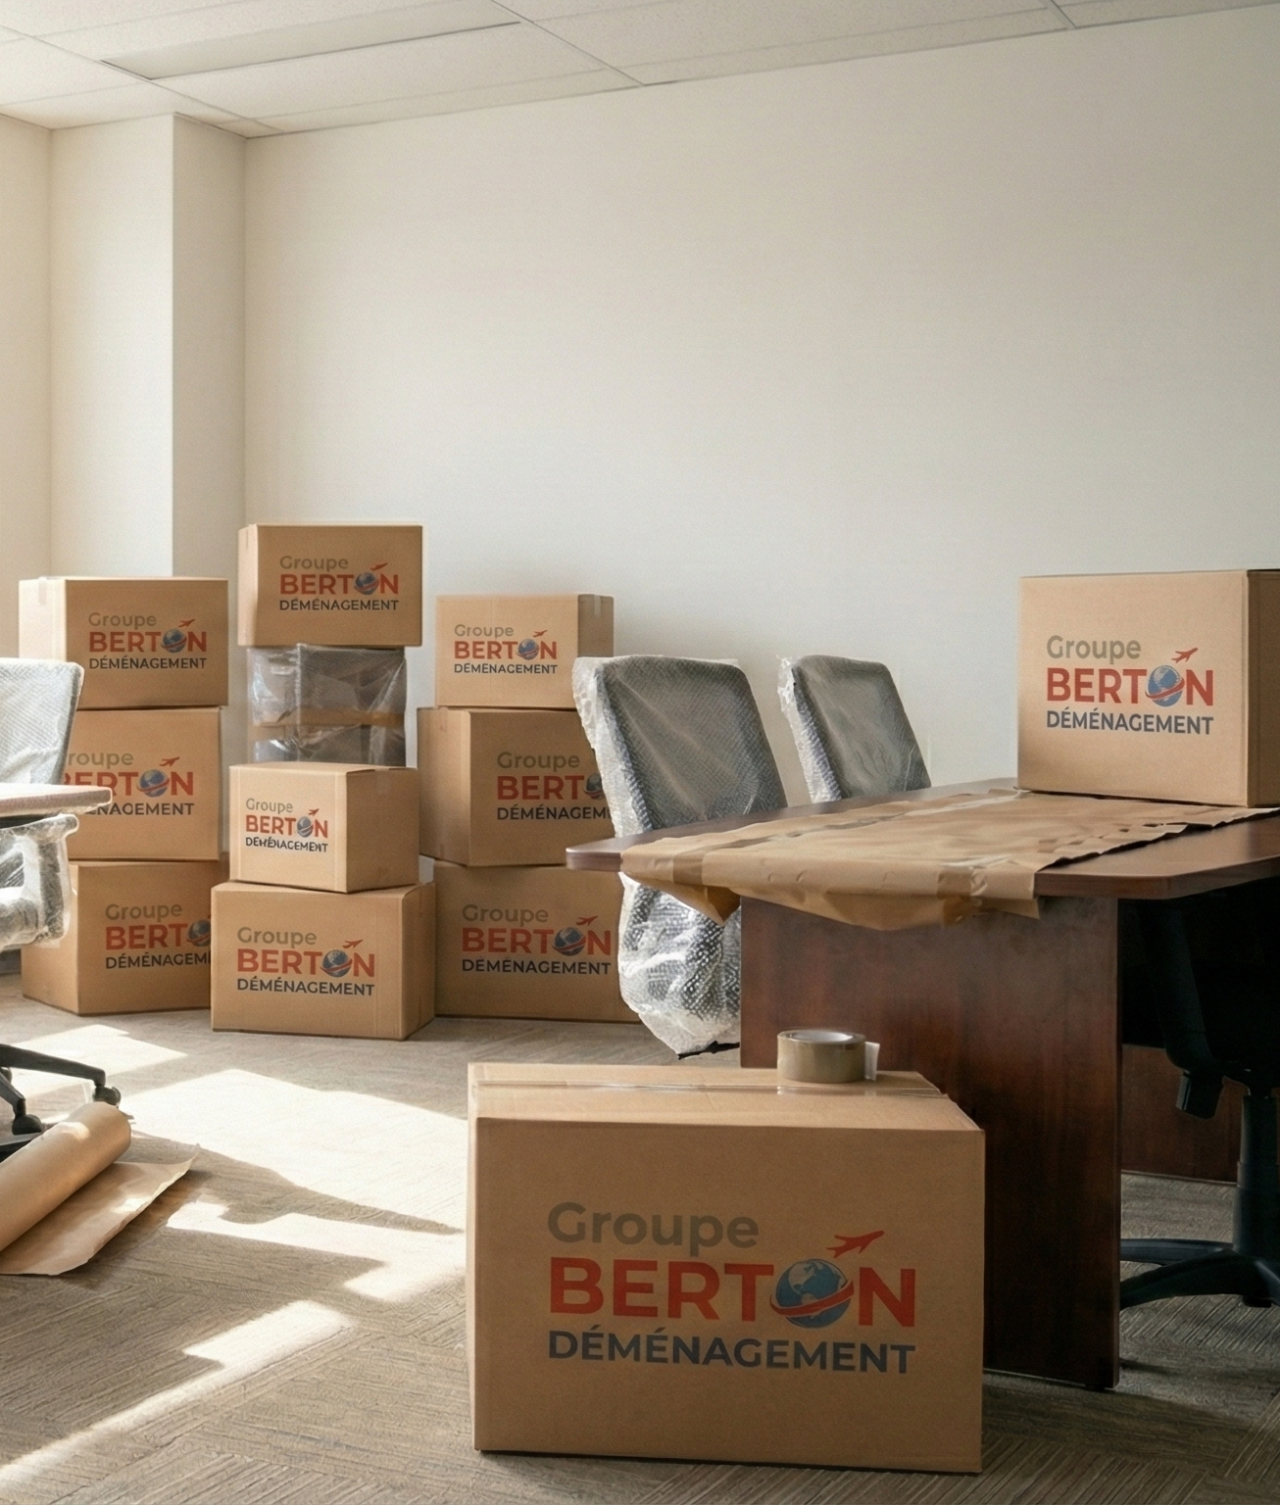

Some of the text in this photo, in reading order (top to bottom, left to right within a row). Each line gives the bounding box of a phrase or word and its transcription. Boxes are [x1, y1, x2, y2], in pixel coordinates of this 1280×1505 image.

[279, 555, 349, 572] Groupe
[280, 572, 399, 596] BERTON
[279, 597, 399, 611] DÉMÉNAGEMENT
[88, 612, 157, 630] Groupe
[454, 624, 515, 639] Groupe
[89, 629, 207, 653] BERTON
[454, 638, 557, 661] BERTON
[1046, 635, 1142, 665] Groupe
[89, 654, 207, 669] DÉMÉNAGEMENT
[1047, 664, 1214, 707] BERTON
[1046, 706, 1214, 735] DÉMÉNAGEMENT
[67, 752, 134, 769] roupe
[497, 751, 580, 772] Groupe
[64, 769, 194, 798] ERTON
[246, 798, 293, 814] Groupe
[497, 803, 612, 820] DÉMÉNAGEM
[246, 814, 329, 839] BERTON
[105, 903, 183, 923] Groupe
[461, 904, 549, 927] Groupe
[105, 920, 211, 950] BERTO
[237, 926, 317, 949] Groupe
[462, 926, 612, 956] BERTON
[105, 951, 211, 969] DÉMÉNAGEM
[237, 948, 375, 978] BERTON
[237, 975, 375, 996] DÉMÉNAGEMENT
[547, 1202, 759, 1257] Groupe
[549, 1257, 916, 1329] BERTON
[548, 1324, 916, 1374] DÉMÉNAGEMENT
